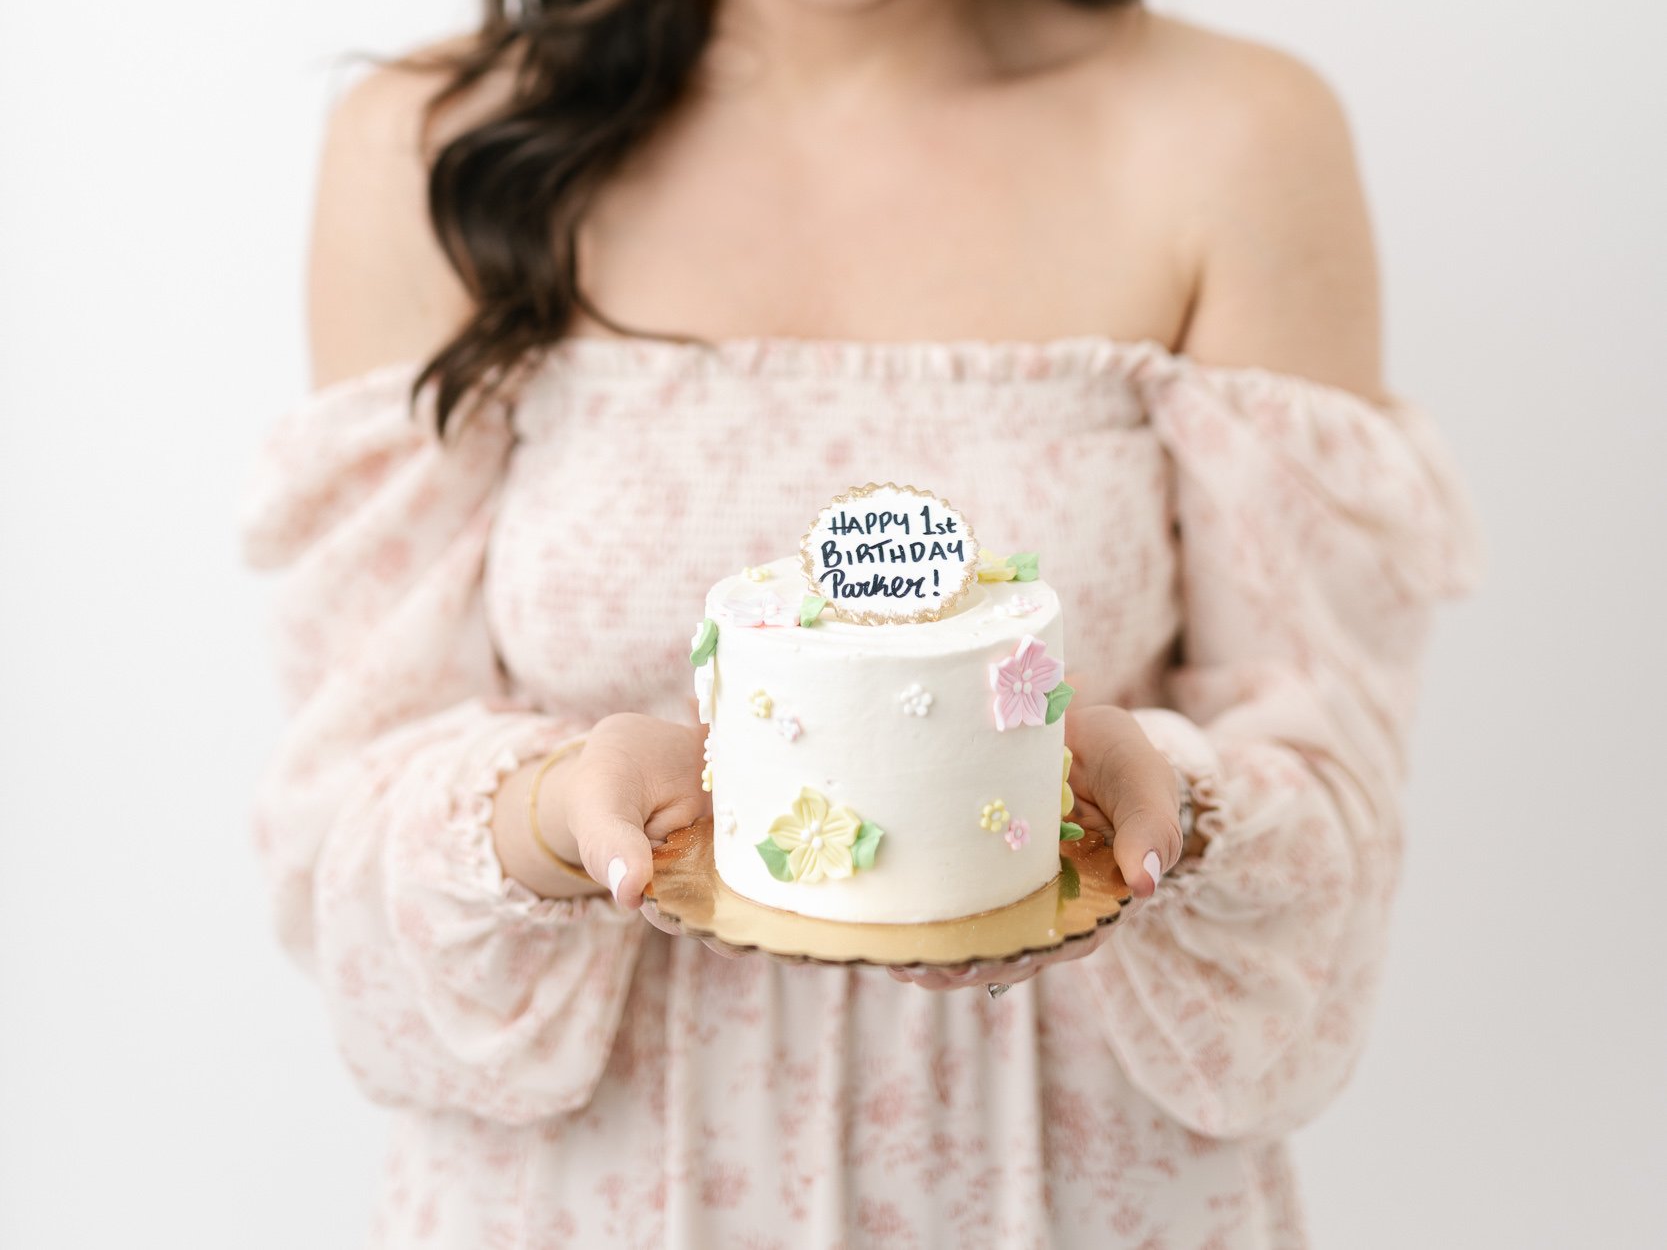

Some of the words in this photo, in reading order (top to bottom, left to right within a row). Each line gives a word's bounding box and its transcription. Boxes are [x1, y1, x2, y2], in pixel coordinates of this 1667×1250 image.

[827, 511, 910, 536] HAPPY
[920, 505, 957, 535] 1st
[821, 538, 965, 568] BIRTHDAY
